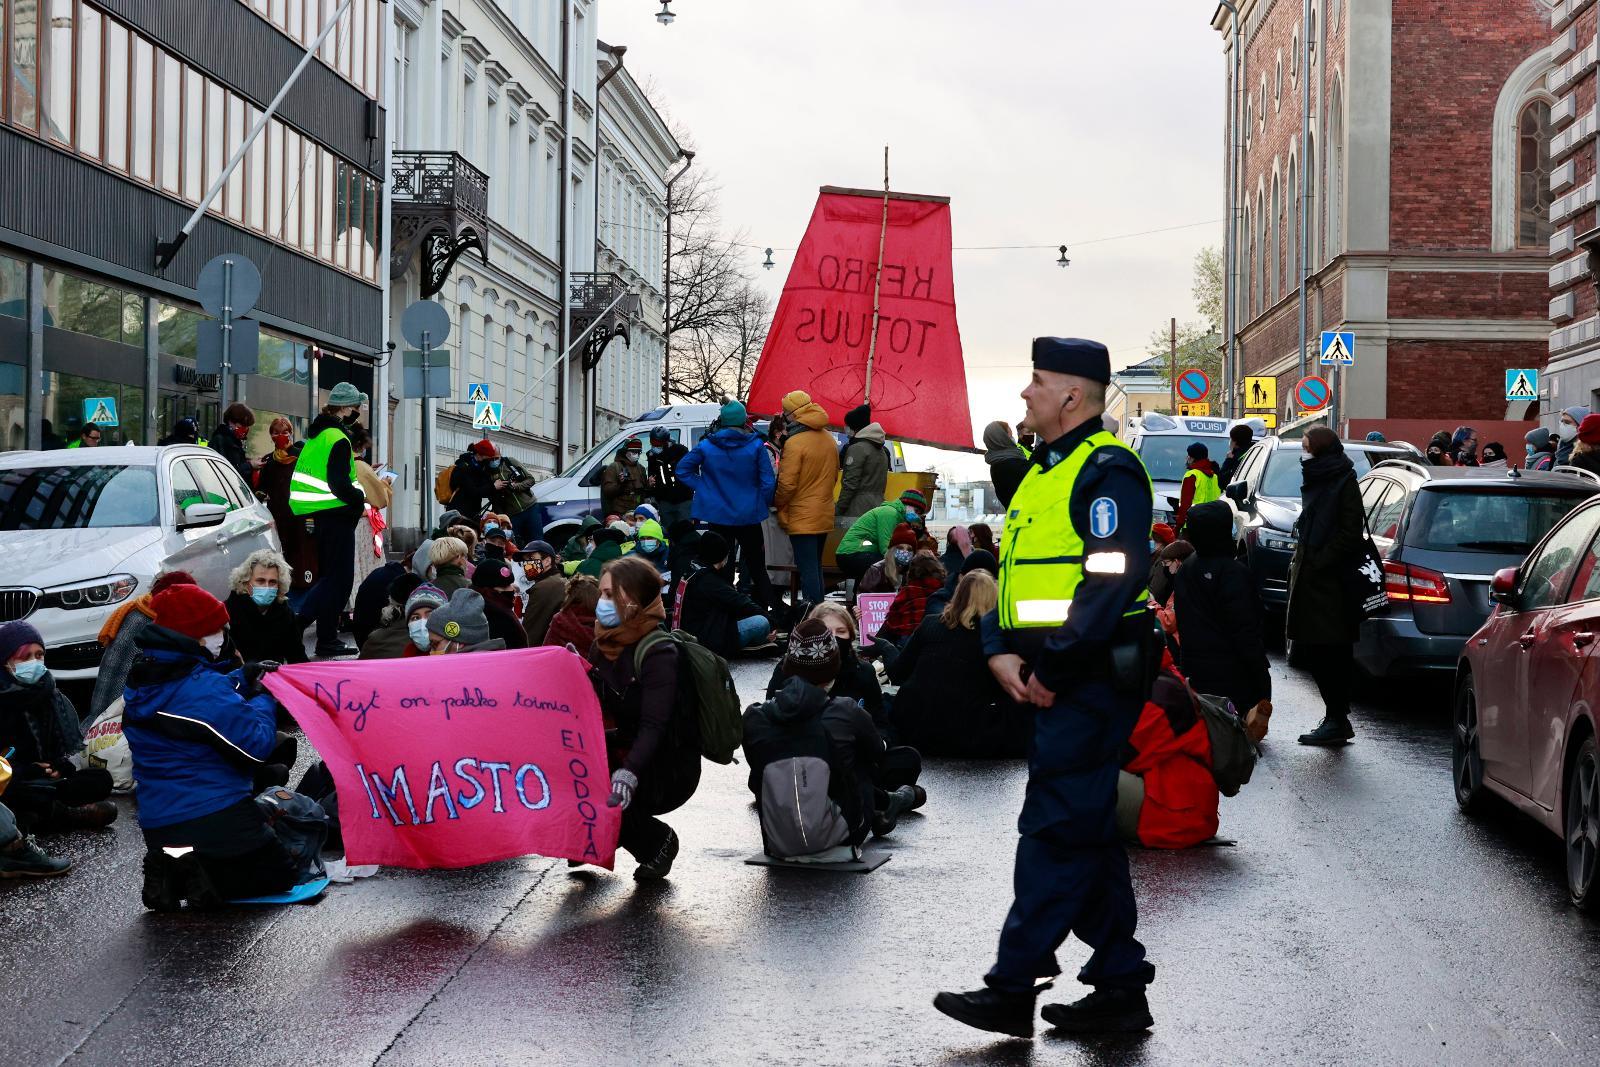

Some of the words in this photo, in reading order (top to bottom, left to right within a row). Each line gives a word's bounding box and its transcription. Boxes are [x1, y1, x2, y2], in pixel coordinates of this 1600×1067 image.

[1190, 421, 1223, 431] POLIISI
[868, 601, 889, 610] STOP
[871, 611, 887, 622] THE
[315, 680, 380, 731] Nyt
[400, 697, 430, 708] on
[441, 687, 498, 720] pakko
[561, 729, 584, 750] EI
[569, 758, 599, 860] ODOTA
